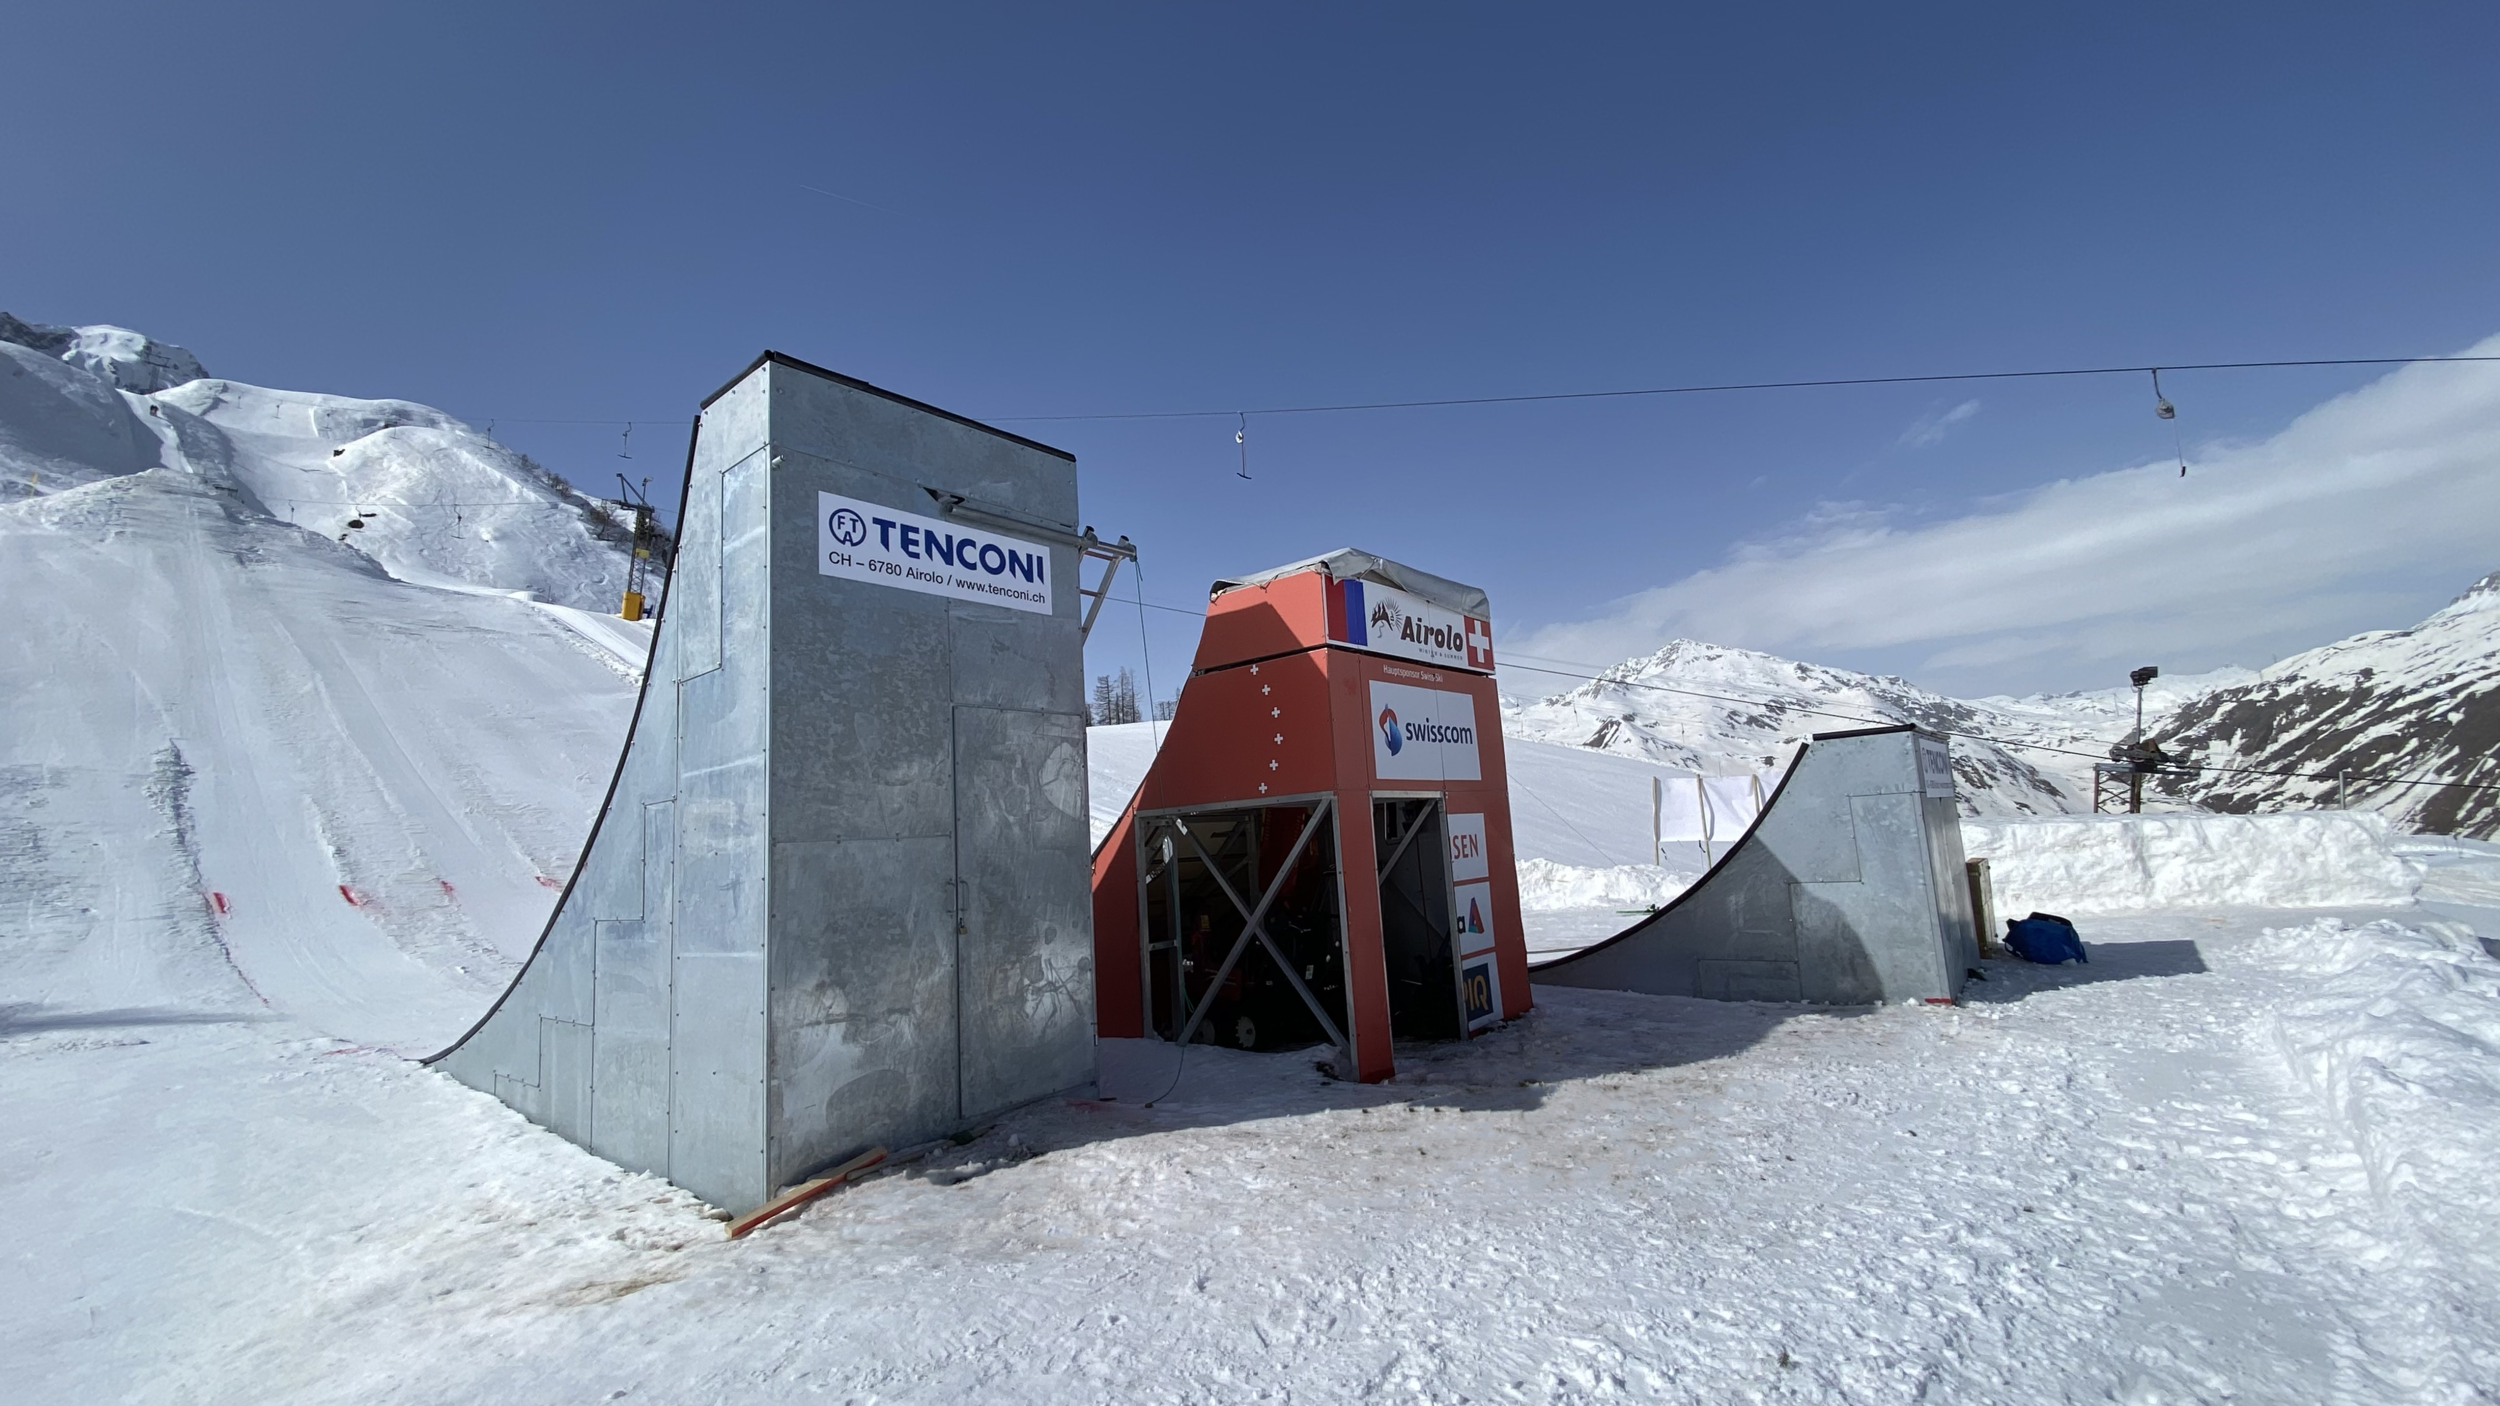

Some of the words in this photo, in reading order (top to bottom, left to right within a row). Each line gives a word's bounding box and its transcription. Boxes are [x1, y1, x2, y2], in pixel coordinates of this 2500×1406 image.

[872, 516, 1045, 585] TENCONI
[829, 551, 852, 567] CH
[869, 559, 902, 576] 6780
[905, 567, 944, 585] Airolo
[955, 579, 1046, 604] www.tenconi.ch
[1401, 616, 1464, 652] Airolo
[1383, 664, 1420, 678] Hauptsponsor
[1405, 717, 1473, 745] swisscom
[1450, 834, 1479, 860] SEN
